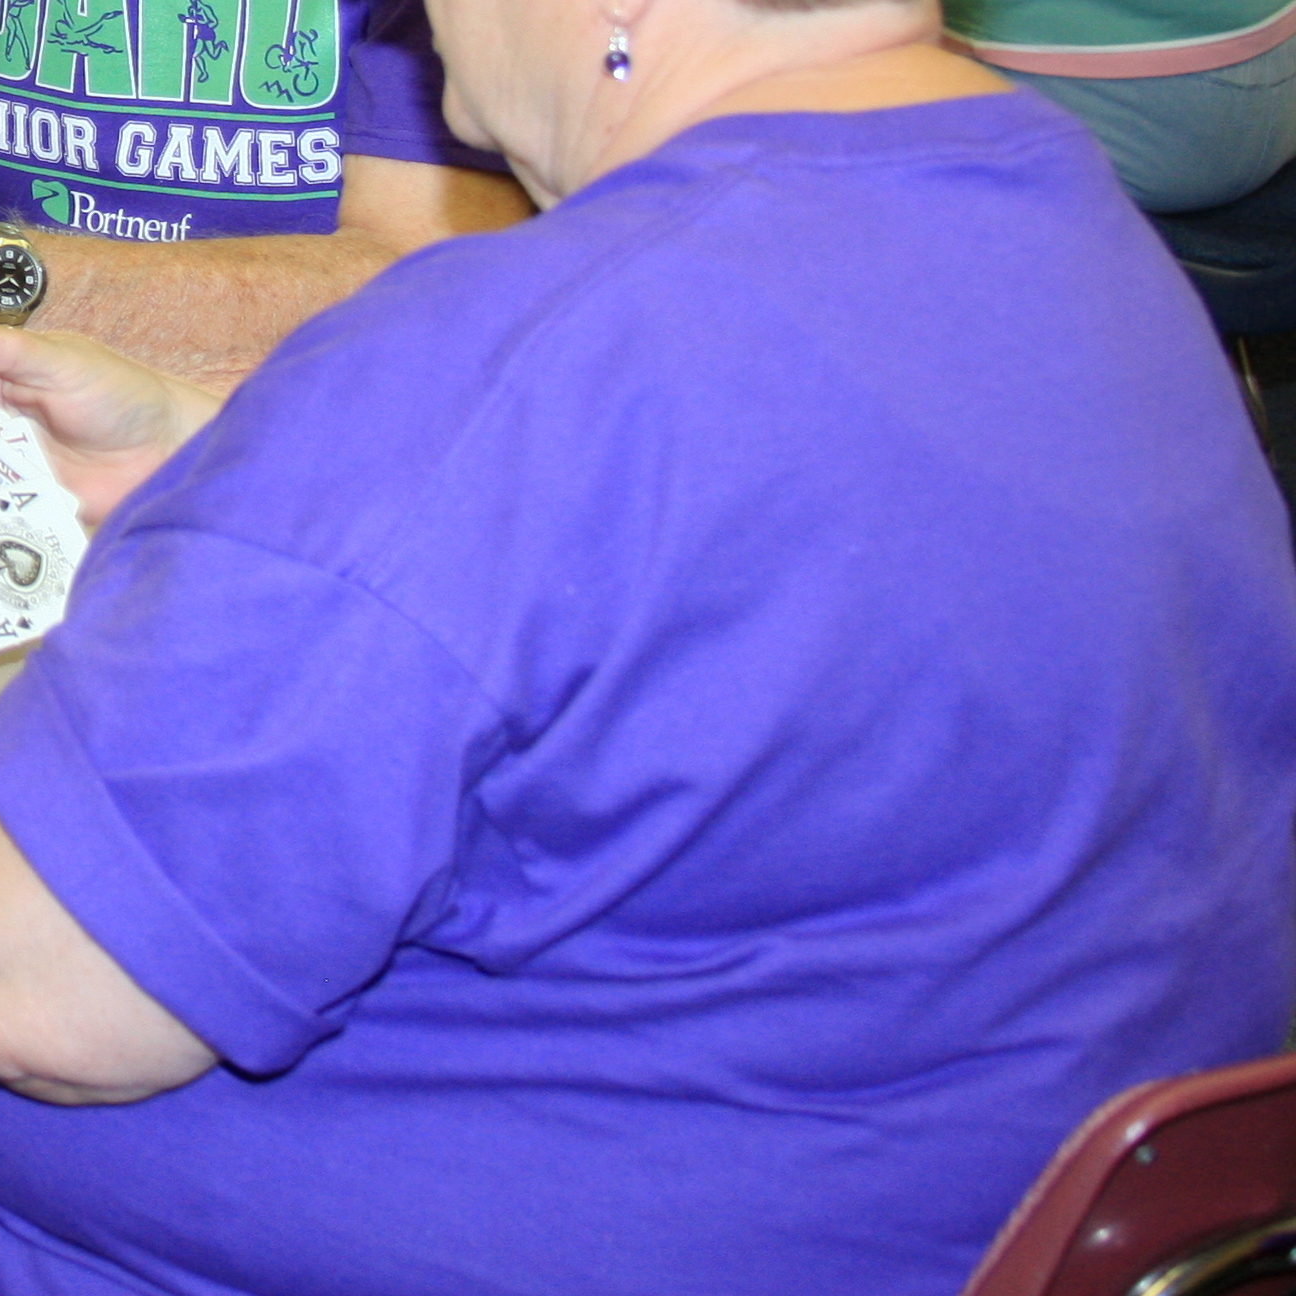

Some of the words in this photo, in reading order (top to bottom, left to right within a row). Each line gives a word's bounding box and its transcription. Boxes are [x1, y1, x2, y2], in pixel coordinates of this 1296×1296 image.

[114, 120, 342, 187] GAMES
[70, 190, 193, 243] Portneuf
[9, 490, 38, 512] A
